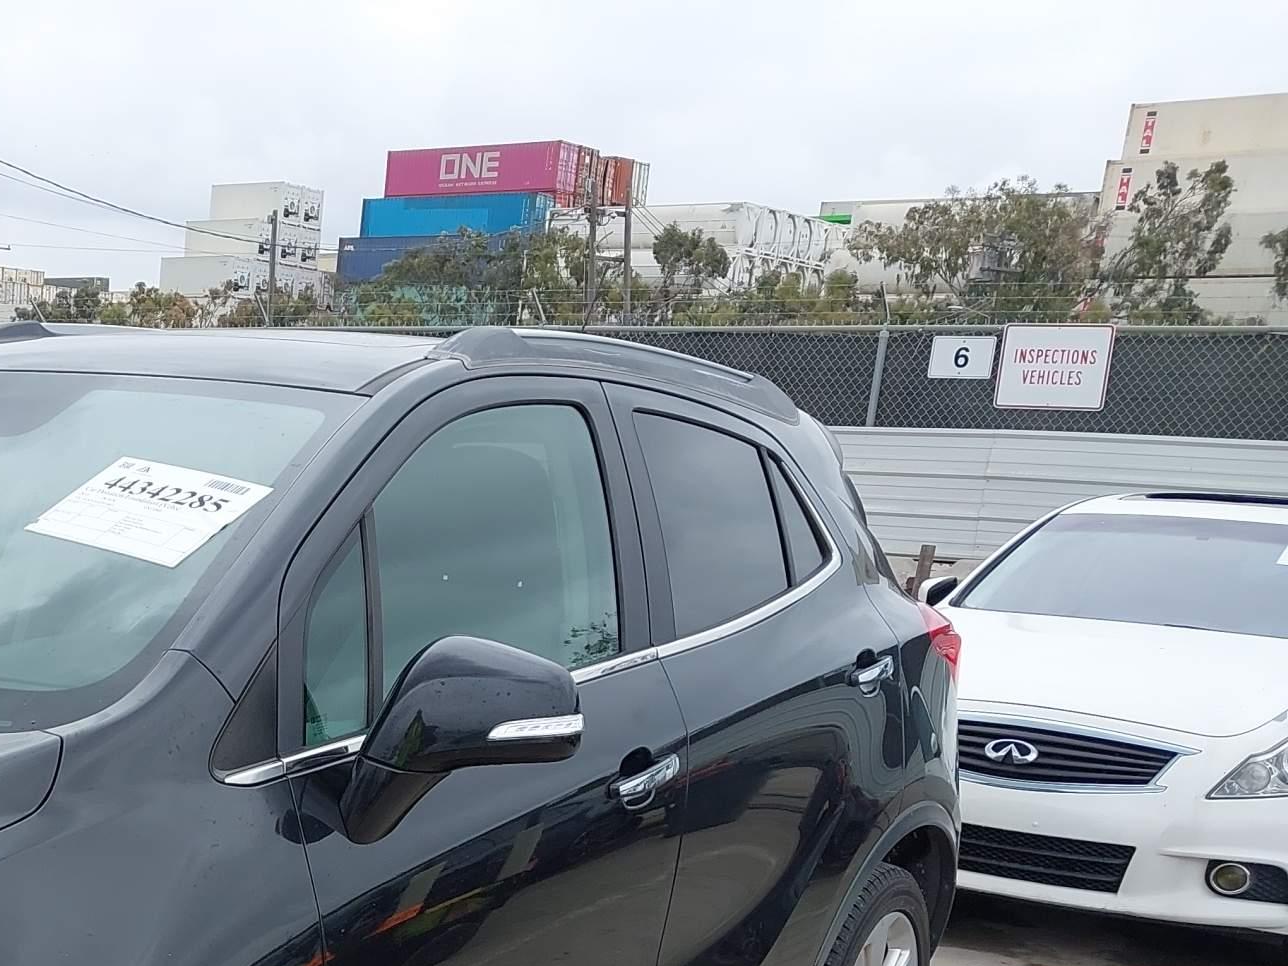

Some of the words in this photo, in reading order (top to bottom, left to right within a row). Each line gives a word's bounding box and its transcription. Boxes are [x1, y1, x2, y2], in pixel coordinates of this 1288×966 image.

[1142, 119, 1157, 147] TAL
[439, 151, 501, 180] ONE
[1117, 176, 1131, 204] TAL
[954, 346, 971, 369] 6
[1013, 348, 1098, 366] INSPECTIONS
[1021, 369, 1083, 387] VEHICLES
[104, 476, 231, 513] 44342285
